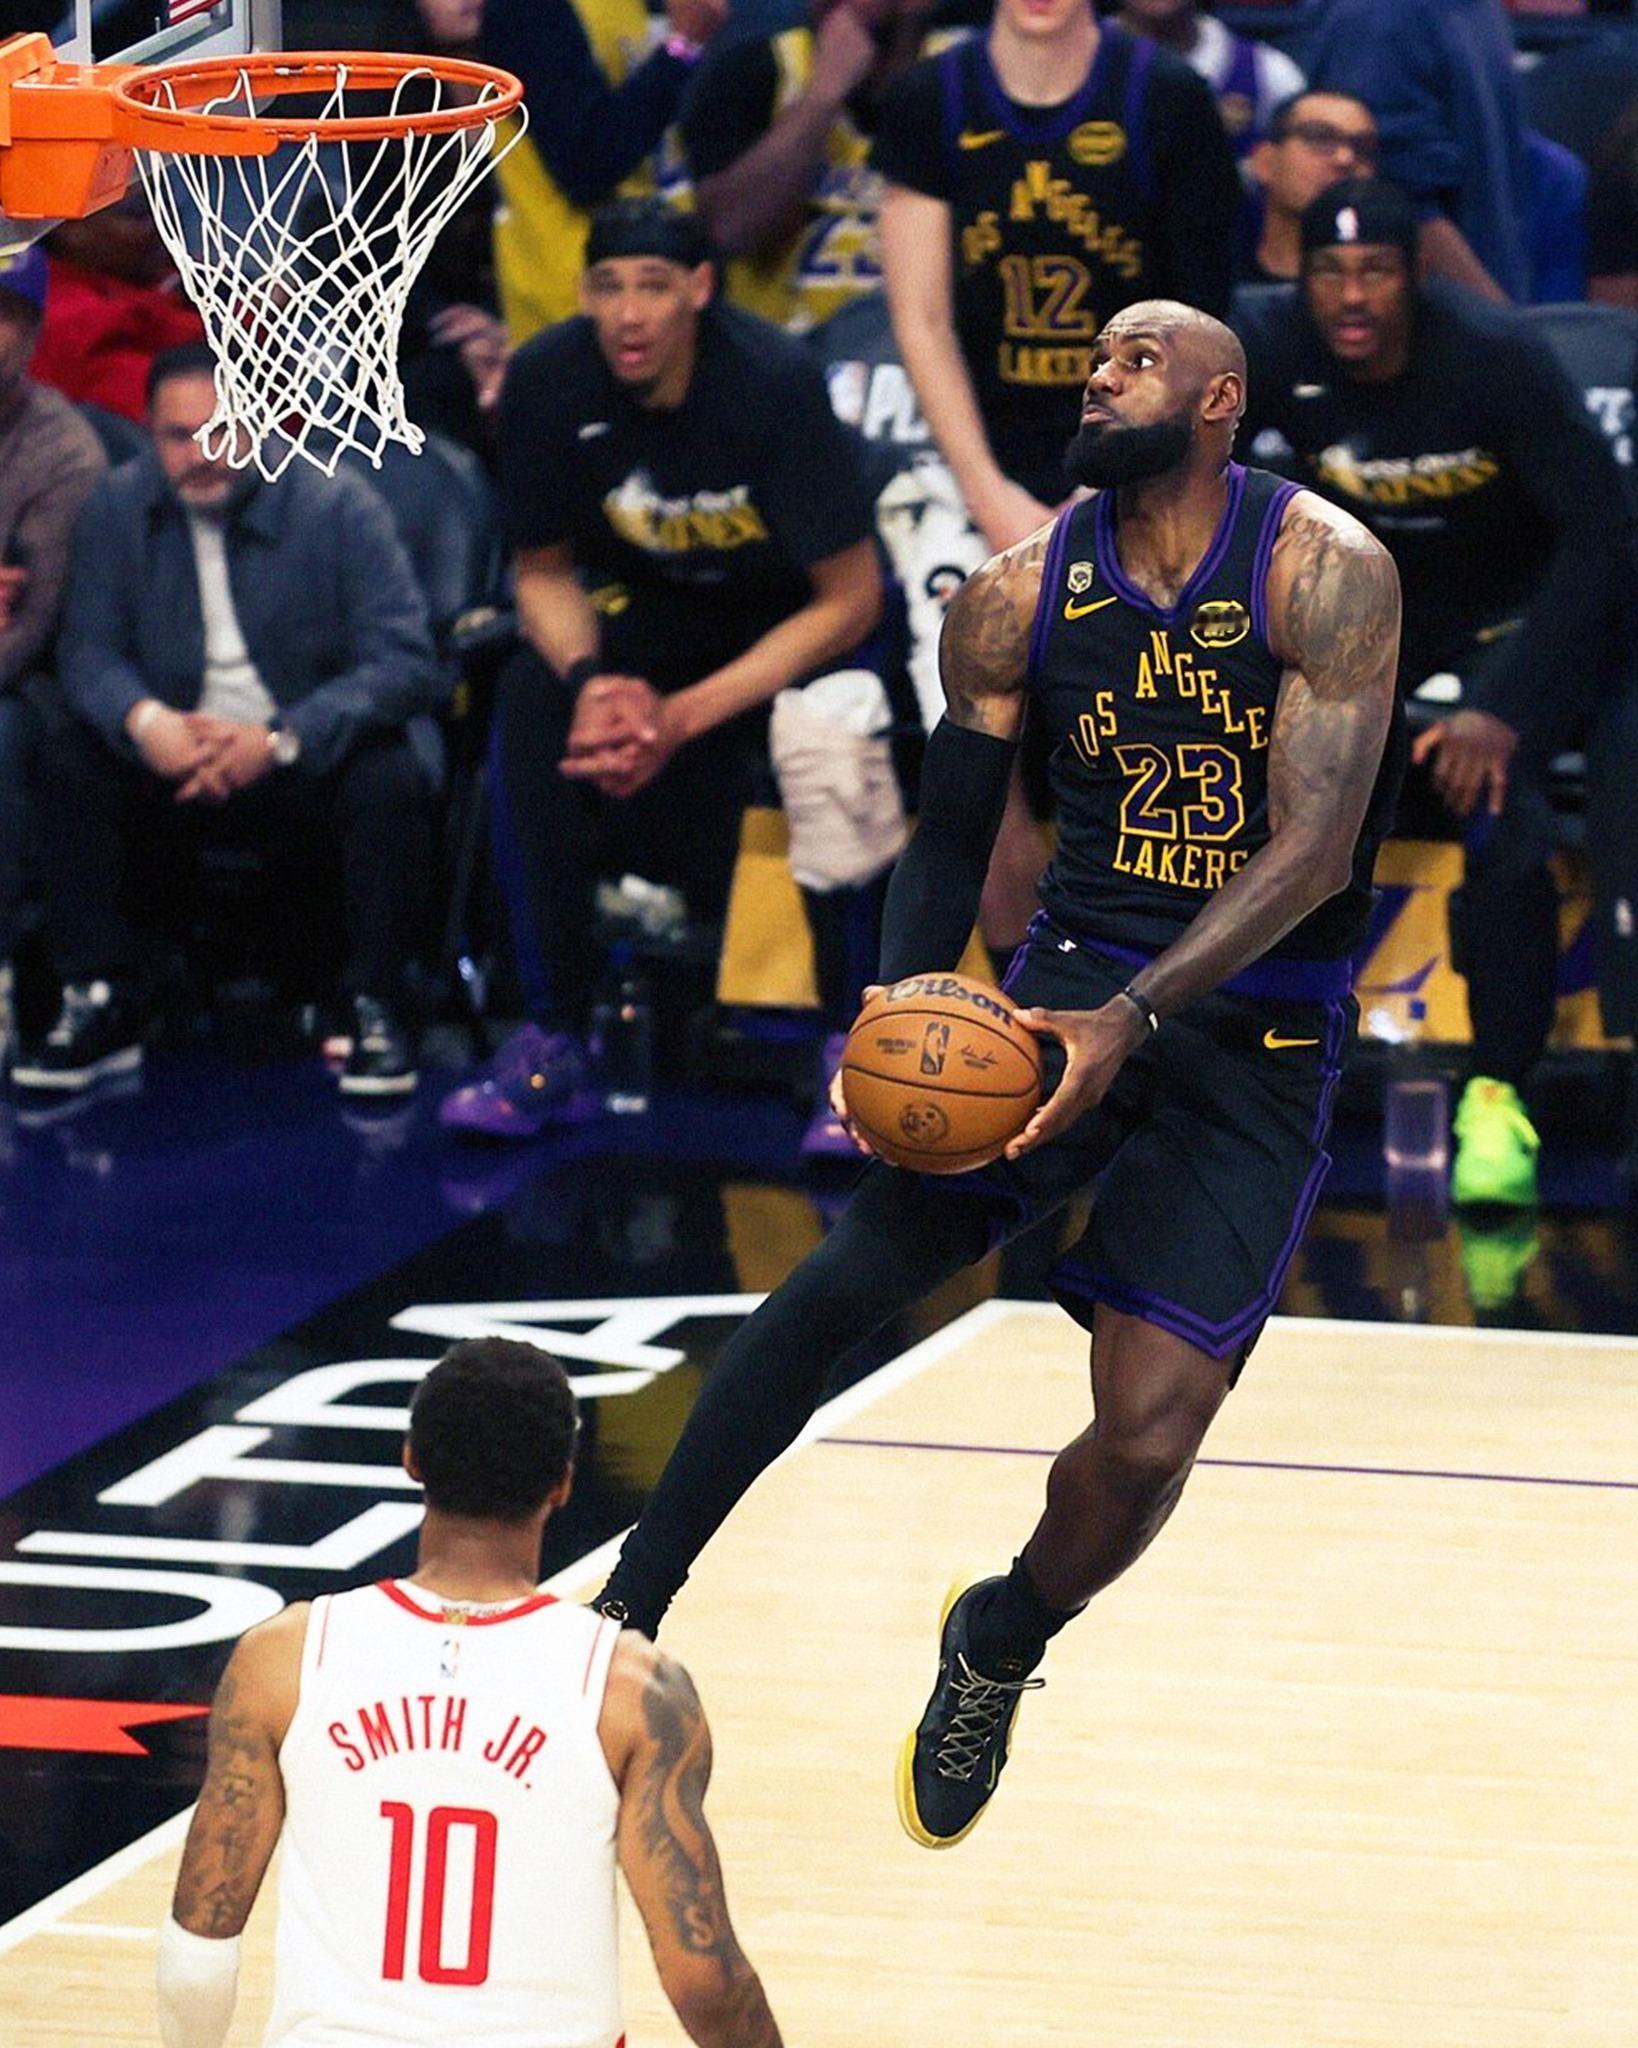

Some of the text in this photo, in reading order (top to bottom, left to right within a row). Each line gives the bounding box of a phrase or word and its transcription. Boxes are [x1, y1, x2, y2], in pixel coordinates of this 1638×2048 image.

[999, 254, 1096, 337] 12
[1135, 630, 1268, 750] ANGELE
[1112, 743, 1245, 842] 23
[886, 978, 1012, 1028] Wilson
[328, 1695, 547, 1791] SMITH JR.
[379, 1800, 498, 1987] 10
